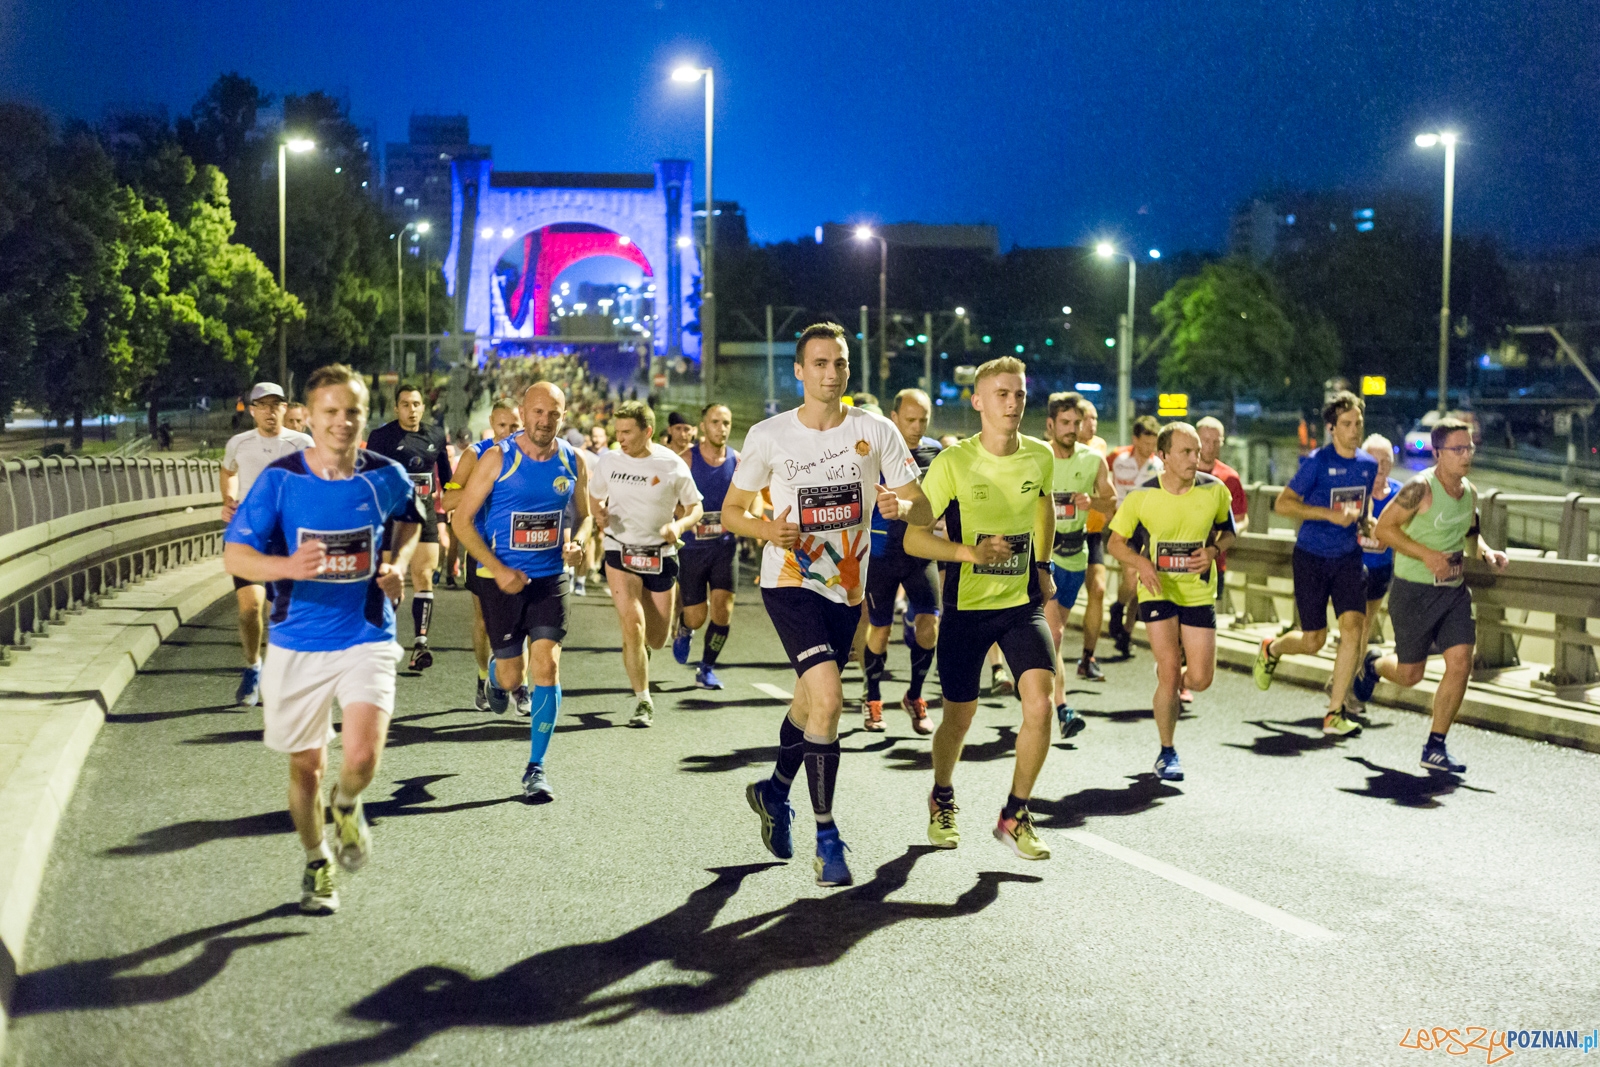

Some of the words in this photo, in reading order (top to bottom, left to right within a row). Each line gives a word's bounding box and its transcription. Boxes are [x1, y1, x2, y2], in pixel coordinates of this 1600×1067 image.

[811, 505, 852, 523] 10566
[526, 530, 550, 543] 1992
[630, 556, 652, 566] 8575
